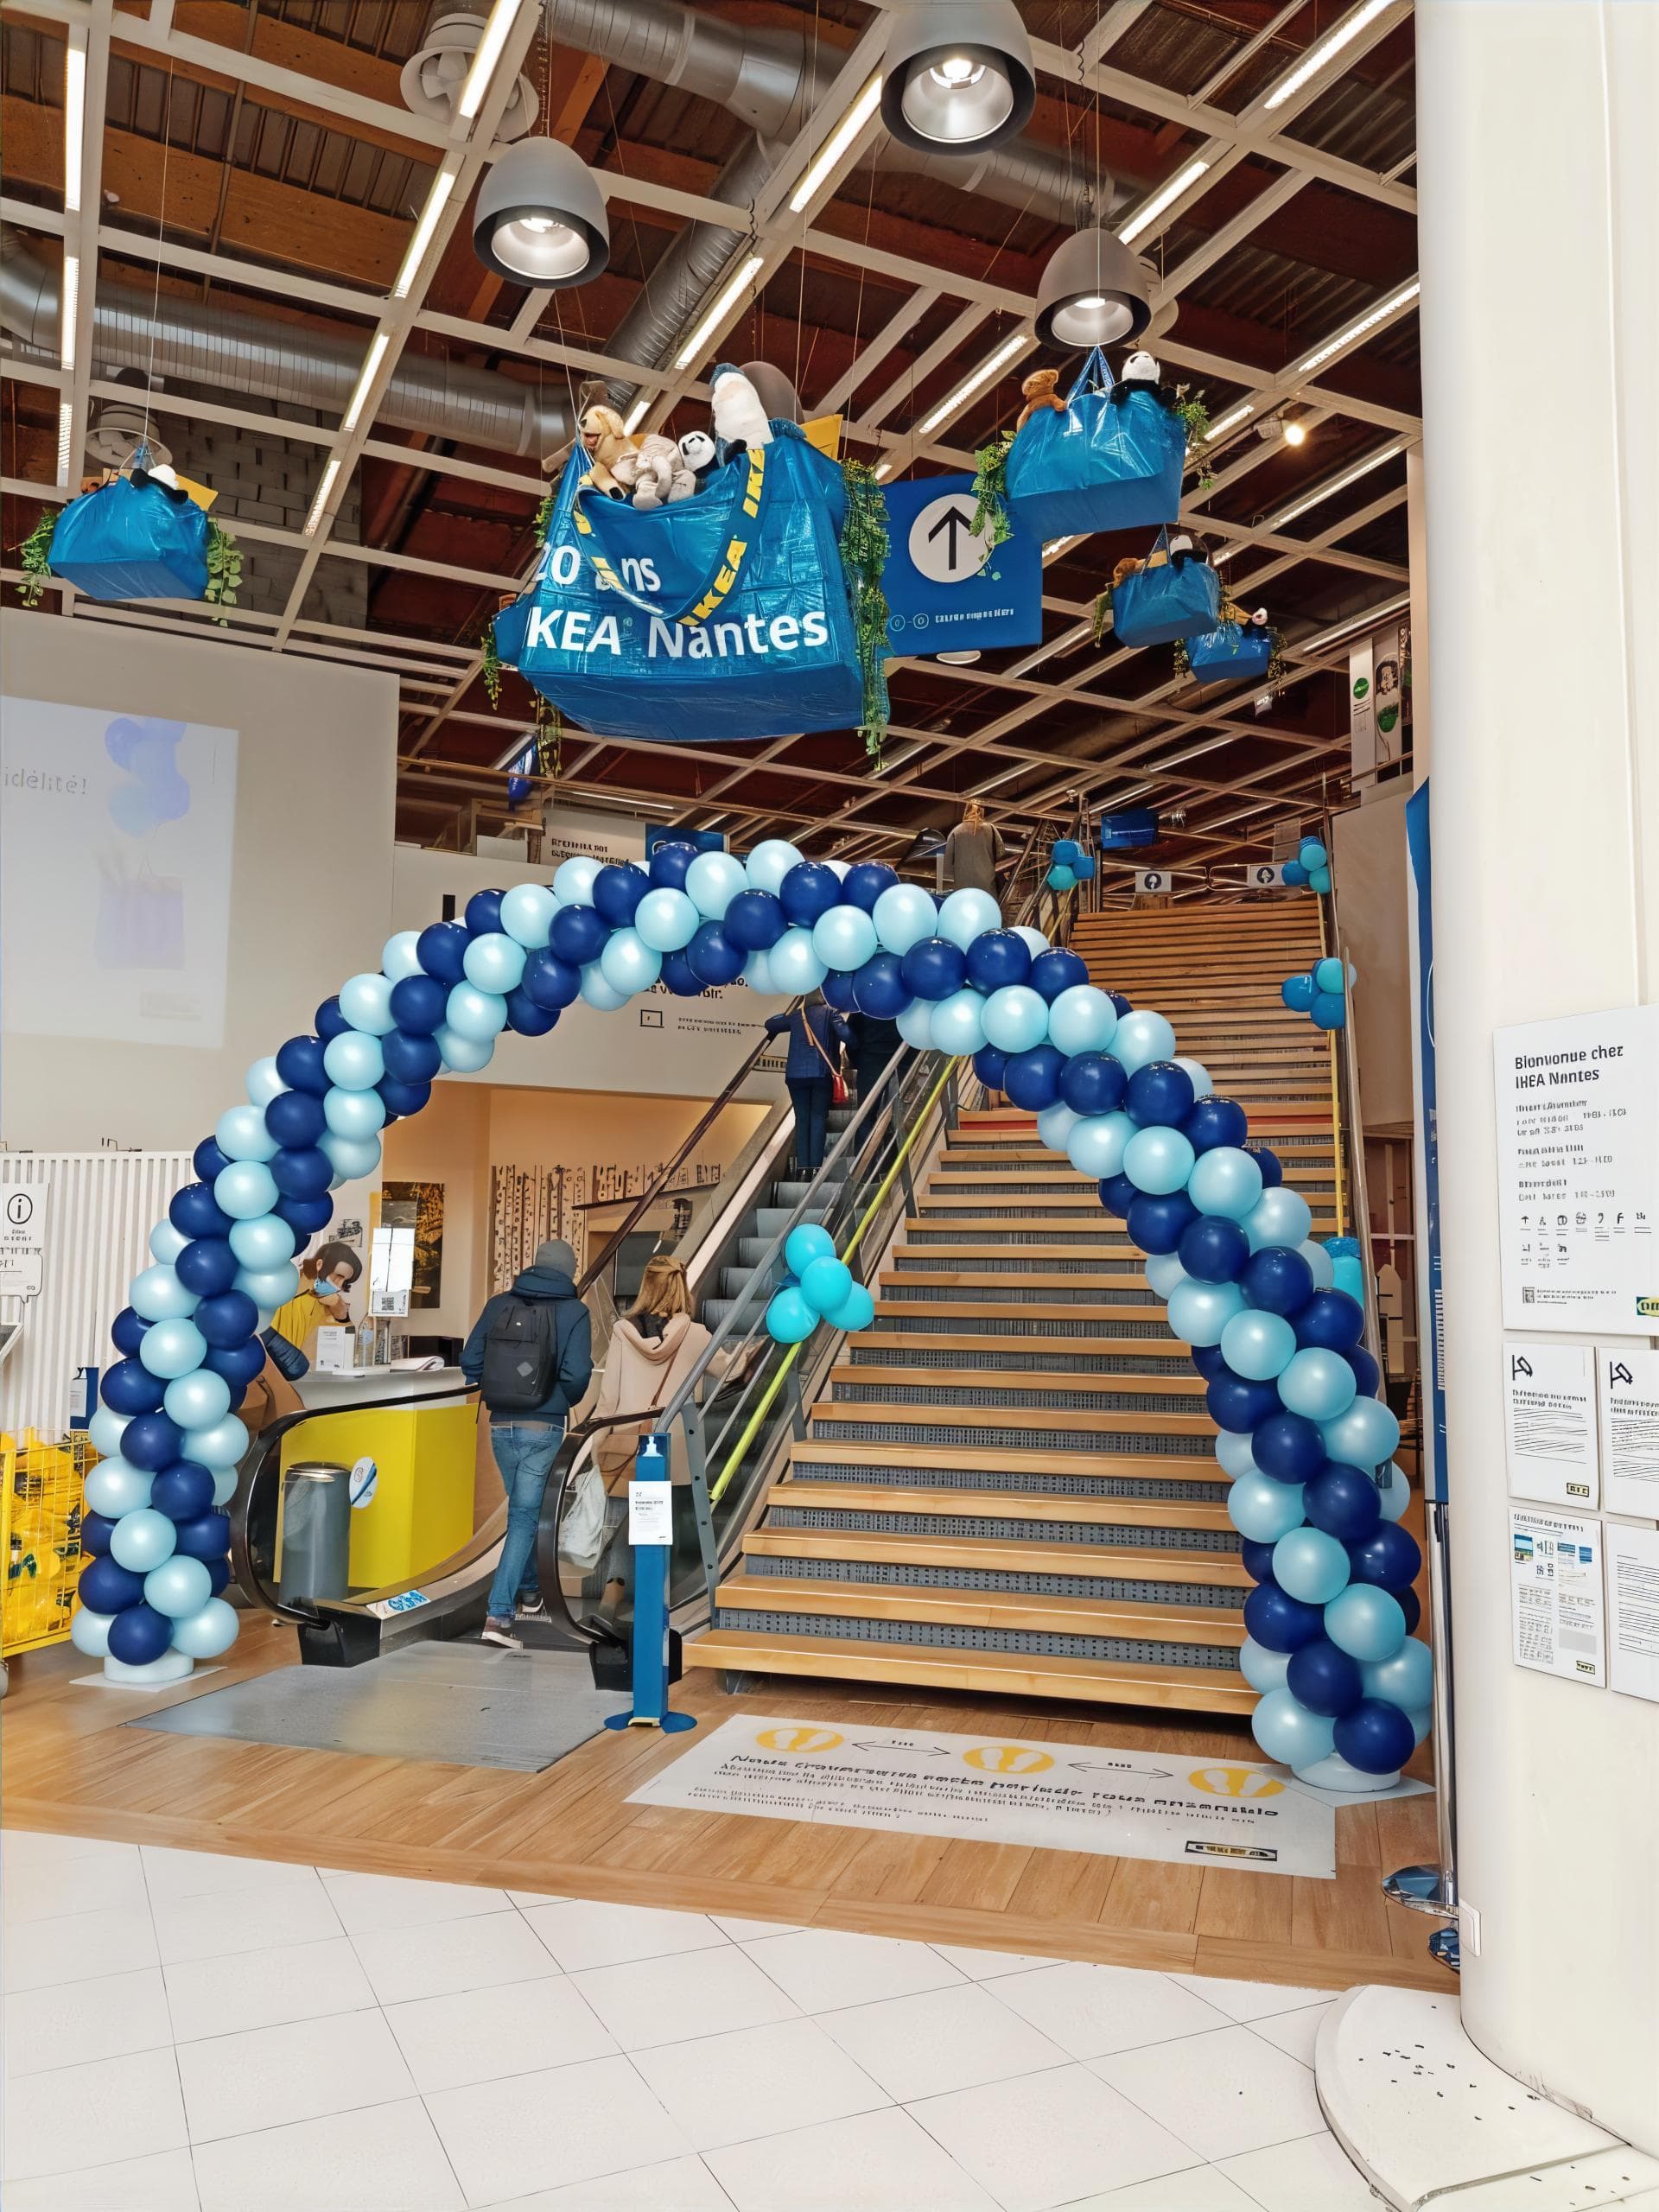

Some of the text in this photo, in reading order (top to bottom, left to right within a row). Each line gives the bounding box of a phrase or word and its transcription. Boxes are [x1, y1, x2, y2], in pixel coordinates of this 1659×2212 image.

[677, 540, 747, 626] IKEA
[523, 607, 829, 659] KEA Nantes
[2, 766, 87, 795] idélité!
